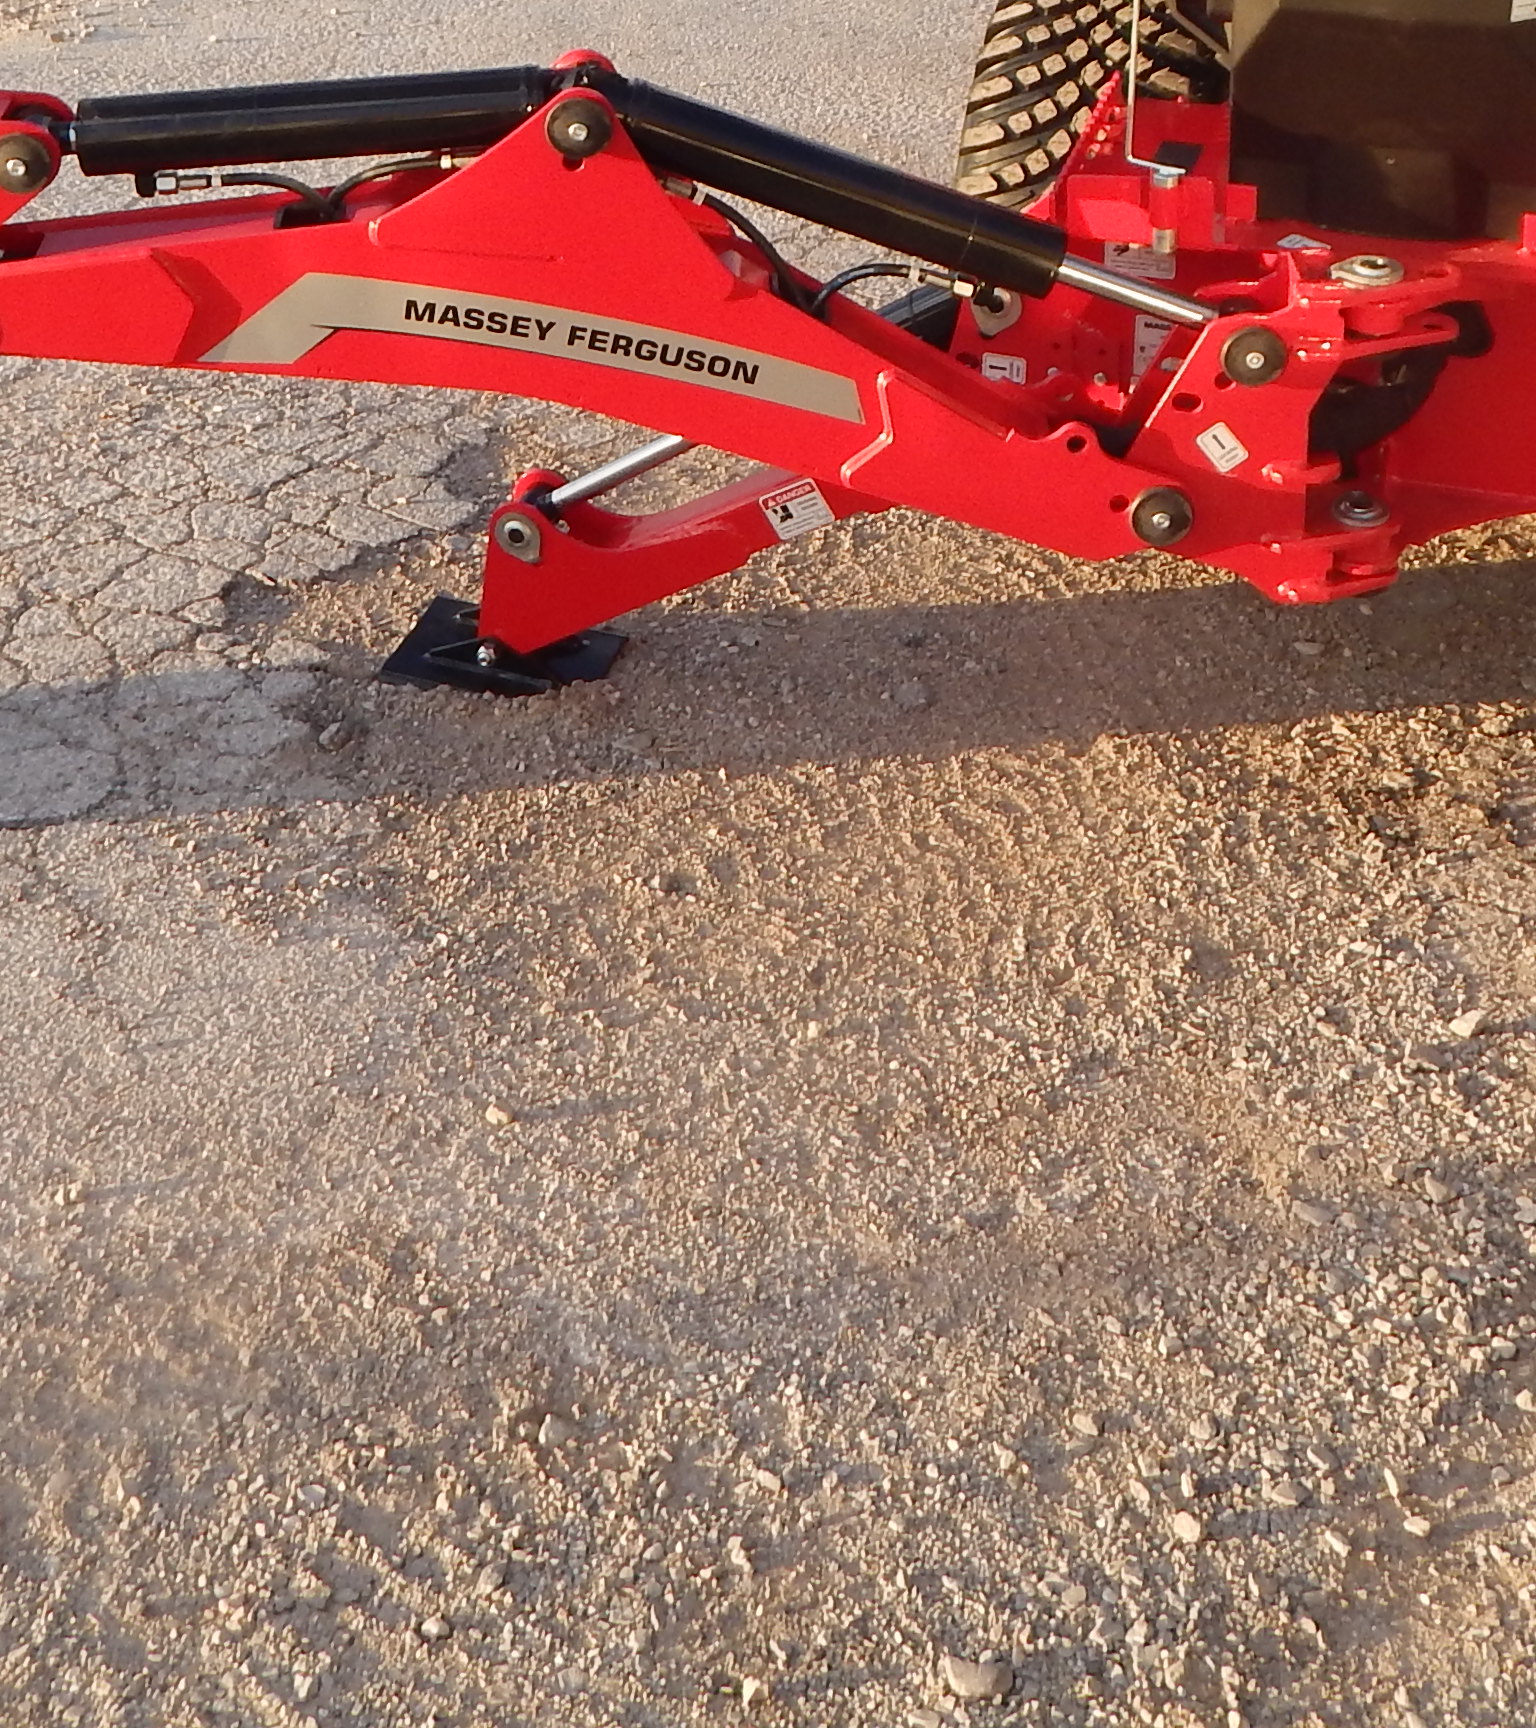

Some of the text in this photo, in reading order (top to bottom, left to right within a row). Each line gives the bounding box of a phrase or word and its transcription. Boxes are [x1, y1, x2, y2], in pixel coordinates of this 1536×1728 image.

[404, 299, 760, 385] MASSEY FERGUSON
[775, 484, 813, 503] DANGER
